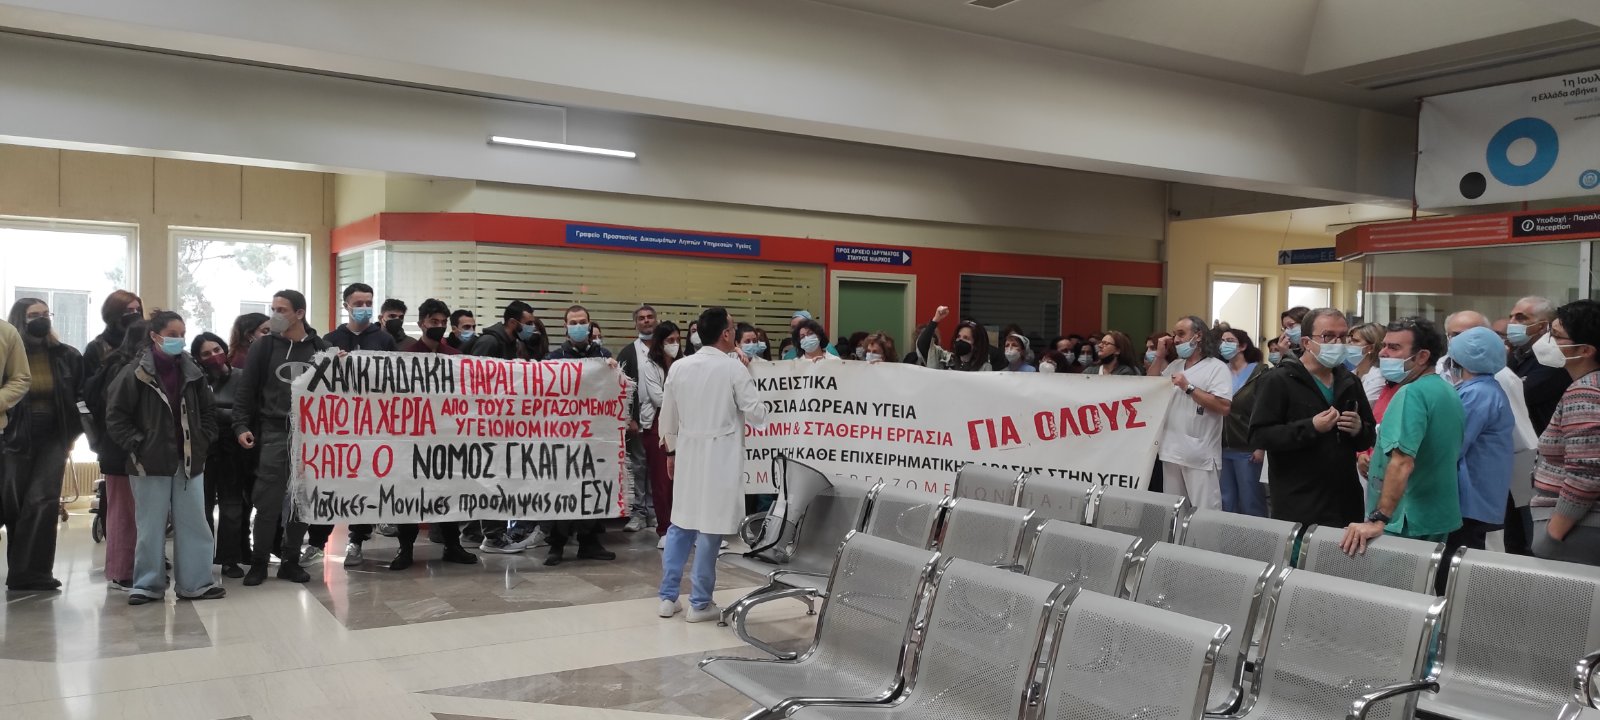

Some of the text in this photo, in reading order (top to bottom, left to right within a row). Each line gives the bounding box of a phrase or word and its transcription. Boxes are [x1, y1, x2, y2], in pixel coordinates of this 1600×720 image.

[1563, 78, 1575, 87] 1η
[1531, 95, 1537, 103] η
[1538, 90, 1568, 101] Ελλάδα
[1570, 86, 1598, 97] σβήνει
[1536, 215, 1567, 224] Υποδοχή
[1536, 224, 1571, 232] Reception
[575, 230, 601, 238] Γραφείο
[603, 232, 638, 242] Προστασίας
[703, 240, 733, 249] Υπηρεσιών
[735, 242, 752, 251] Υγείας
[847, 254, 868, 262] ΣΤΑΥΡΟΣ
[307, 355, 455, 394] ΧΑΛΚΙΑΔΑΚΗ
[753, 375, 838, 391] ΚΛΕΙΣΤΙΚΑ
[352, 396, 373, 435] ΤΑ
[376, 396, 436, 435] ΧΕΡΙΑ
[441, 398, 468, 416] ΑΠΟ
[475, 398, 515, 416] ΤΟΥΣ
[799, 399, 867, 416] ΔΩΡΕΑΝ
[872, 403, 917, 420] ΥΓΕΙΑ
[456, 418, 593, 437] ΥΓΕΙΟΝΟΜΙΚΟΥΣ
[804, 421, 882, 441] ΣΤΑΘΕΡΗ
[887, 427, 953, 447] ΕΡΓΑΣΙΑ
[967, 416, 1022, 450] ΓΙΑ
[1033, 397, 1147, 441] ΟΛΟΥΣ
[372, 444, 394, 478] Ο
[413, 442, 497, 480] ΝΟΜΟΣ
[796, 447, 837, 462] ΚΑΘΕ
[840, 450, 974, 473] ΕΠΙΧΕΙΡΗΜΑΤΙΚΗ
[581, 480, 613, 516] ΕΣΥ
